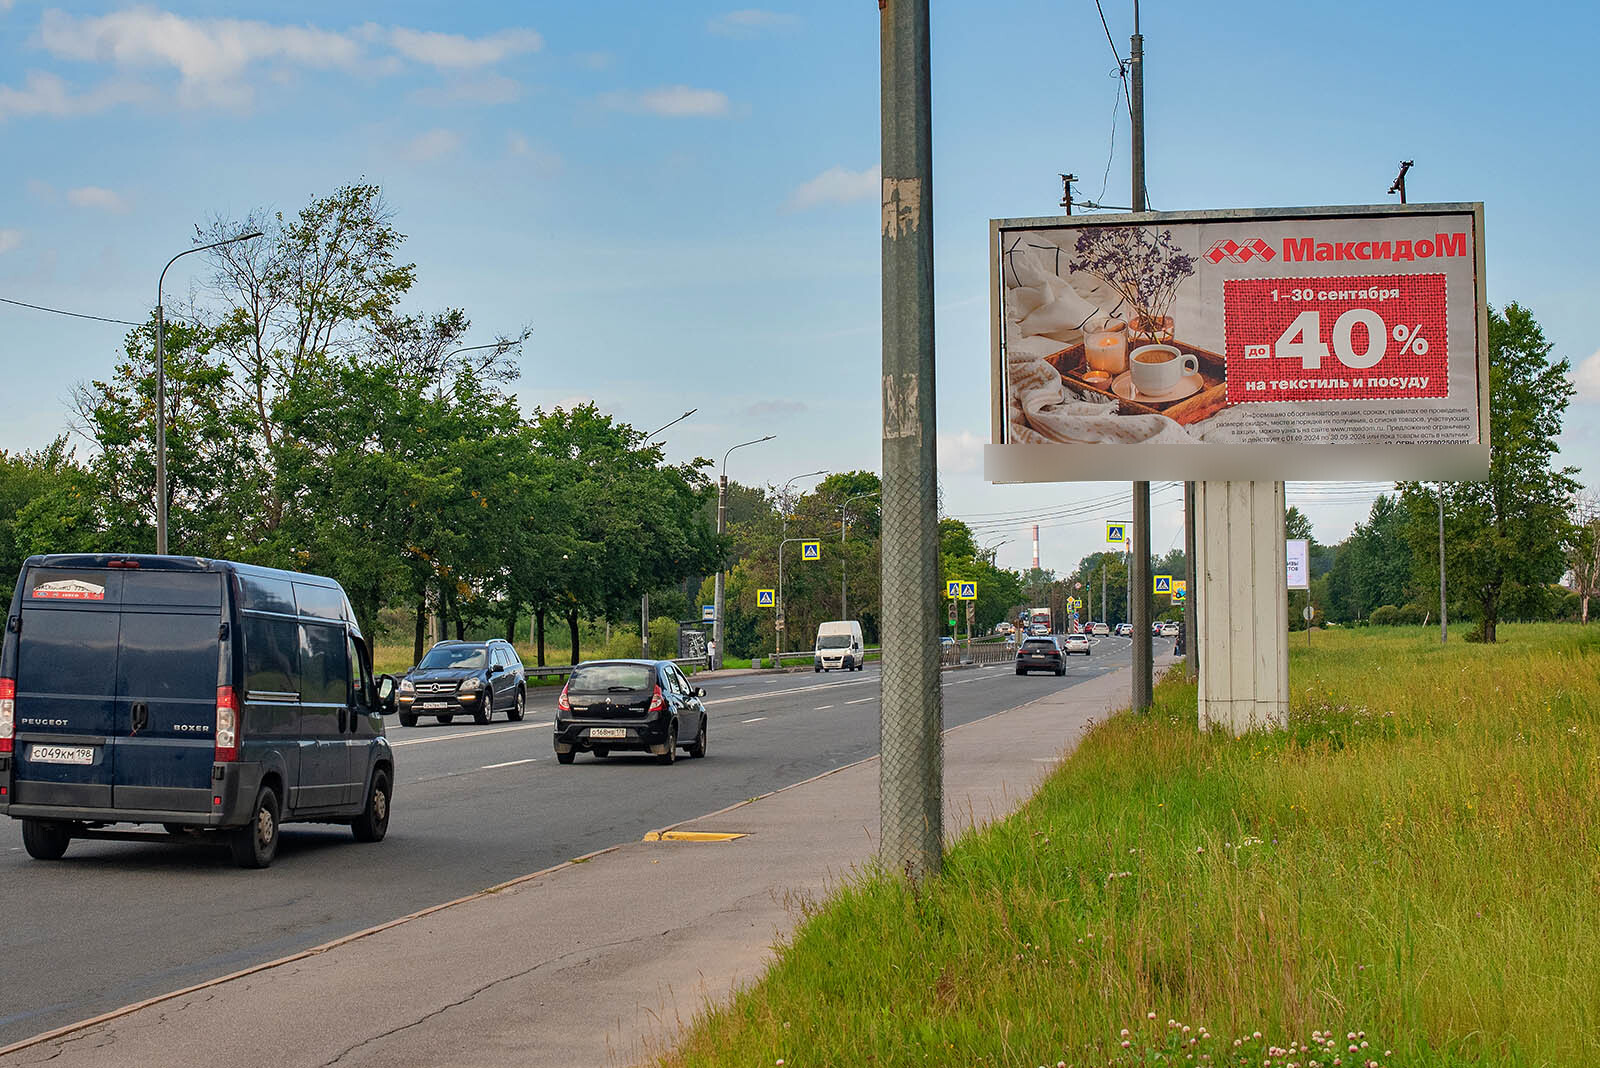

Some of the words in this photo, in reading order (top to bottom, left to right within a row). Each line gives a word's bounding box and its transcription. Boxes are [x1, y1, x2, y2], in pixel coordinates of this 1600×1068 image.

[1282, 232, 1467, 262] МаксидоМ
[1317, 286, 1399, 301] сентября
[1249, 346, 1266, 357] до
[1246, 380, 1266, 391] на
[1270, 377, 1349, 391] текстиль
[1353, 378, 1365, 390] и
[1369, 375, 1429, 391] посуду
[21, 718, 69, 726] PEUGEOT
[174, 724, 209, 732] BOXER
